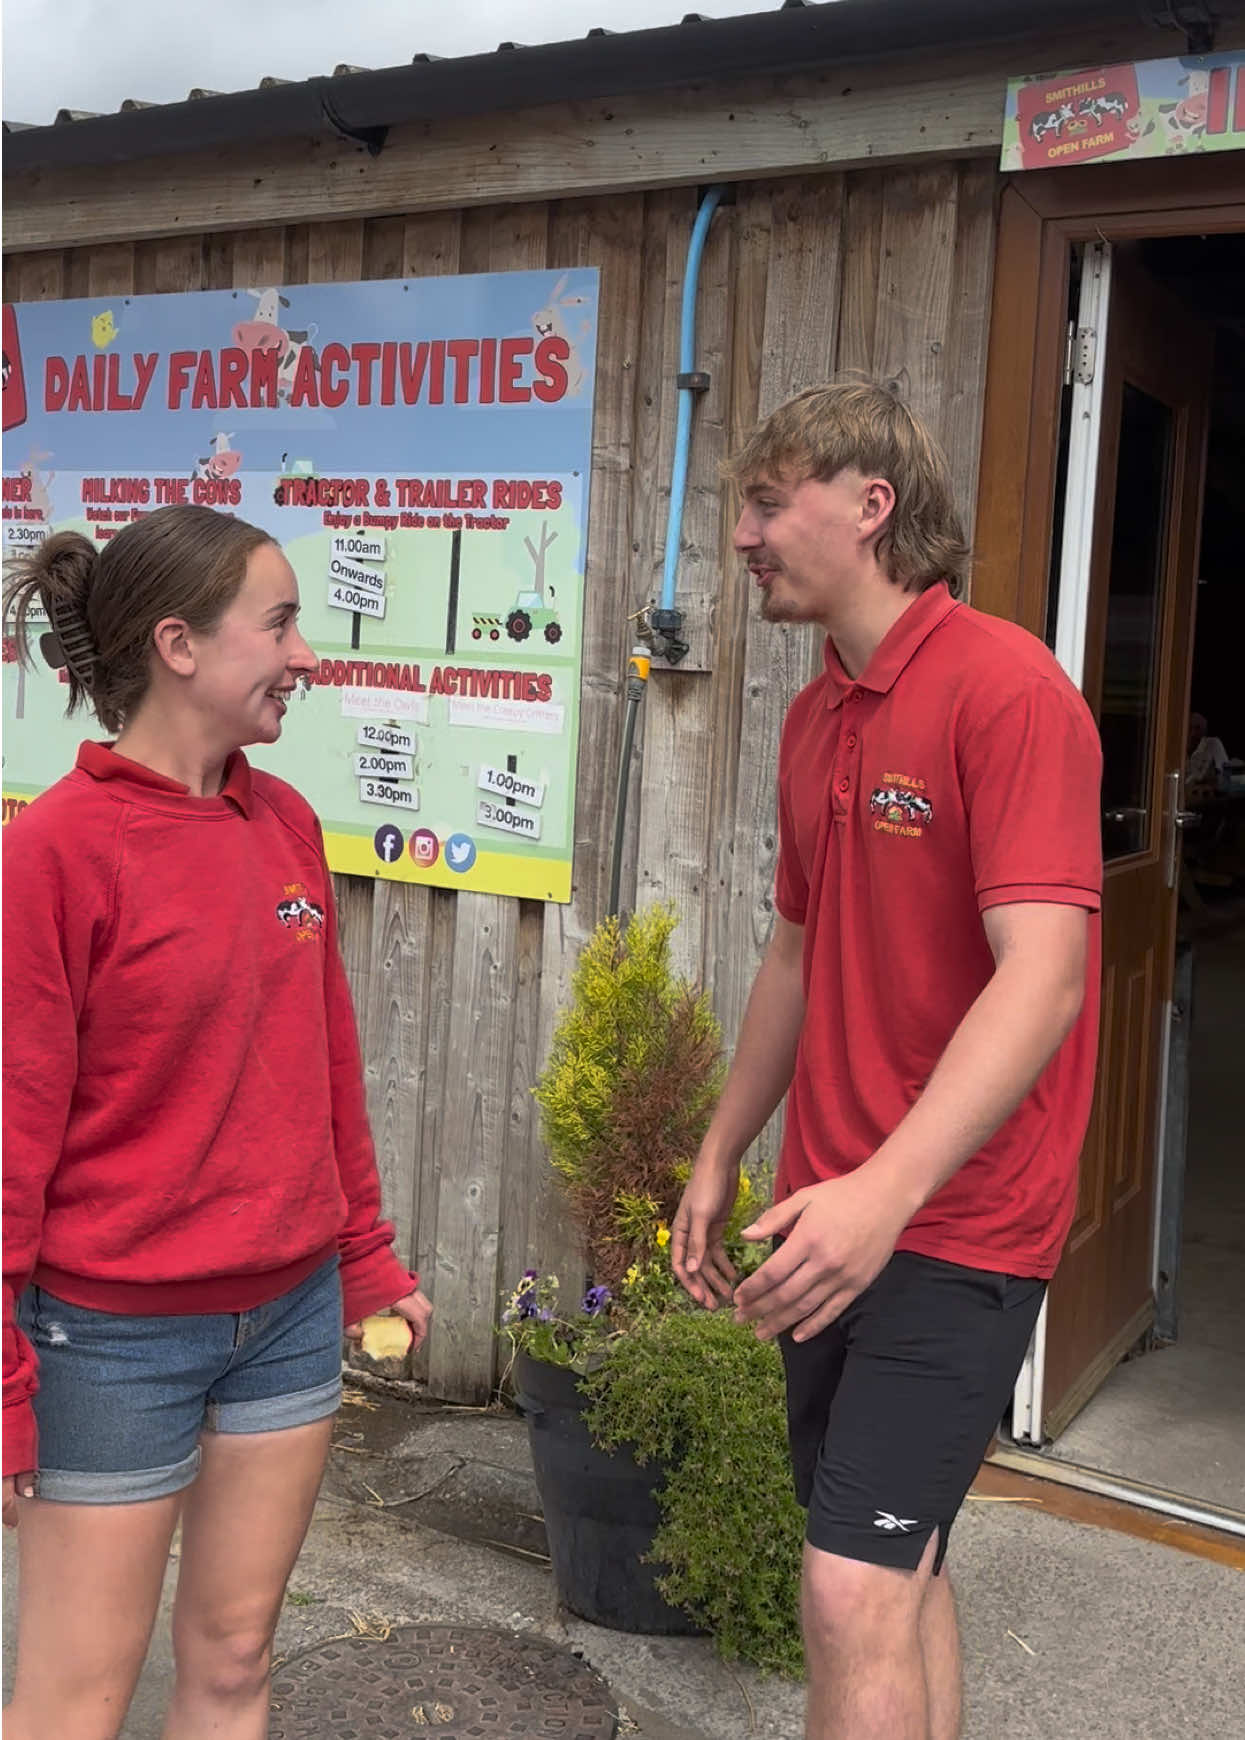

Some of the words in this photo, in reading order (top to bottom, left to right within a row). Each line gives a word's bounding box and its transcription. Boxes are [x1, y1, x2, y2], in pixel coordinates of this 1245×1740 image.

[1045, 78, 1106, 104] SMITHILLS
[1047, 140, 1080, 159] OPEN
[1081, 131, 1114, 151] FARM
[45, 353, 158, 411] DAILY
[169, 348, 277, 410] FARM
[291, 336, 570, 408] ACTIVITIES
[82, 477, 150, 504] MILKING
[154, 477, 190, 505] THE
[192, 477, 242, 506] COWS
[279, 477, 371, 508] TRACTOR
[374, 478, 392, 508] &
[396, 479, 488, 509] TRAILER
[492, 480, 563, 510] RIDES
[323, 511, 351, 530] Enjoy
[363, 511, 399, 531] Bumpy
[400, 512, 425, 528] Ride
[427, 514, 441, 528] on
[443, 511, 462, 529] the
[465, 513, 511, 530] Tractor
[8, 528, 45, 543] 2.30pm
[334, 538, 381, 555] 11.00am
[330, 559, 384, 589] Onwards
[333, 590, 379, 612] 4.00pm
[309, 658, 427, 693] ADDITIONAL
[430, 666, 552, 702] ACTIVITIES
[362, 726, 411, 748] 12.00pm
[359, 756, 406, 772] 2.00pm
[366, 783, 412, 804] 3.30pm
[487, 770, 536, 799] 1.00pm
[484, 803, 535, 832] 3.00pm
